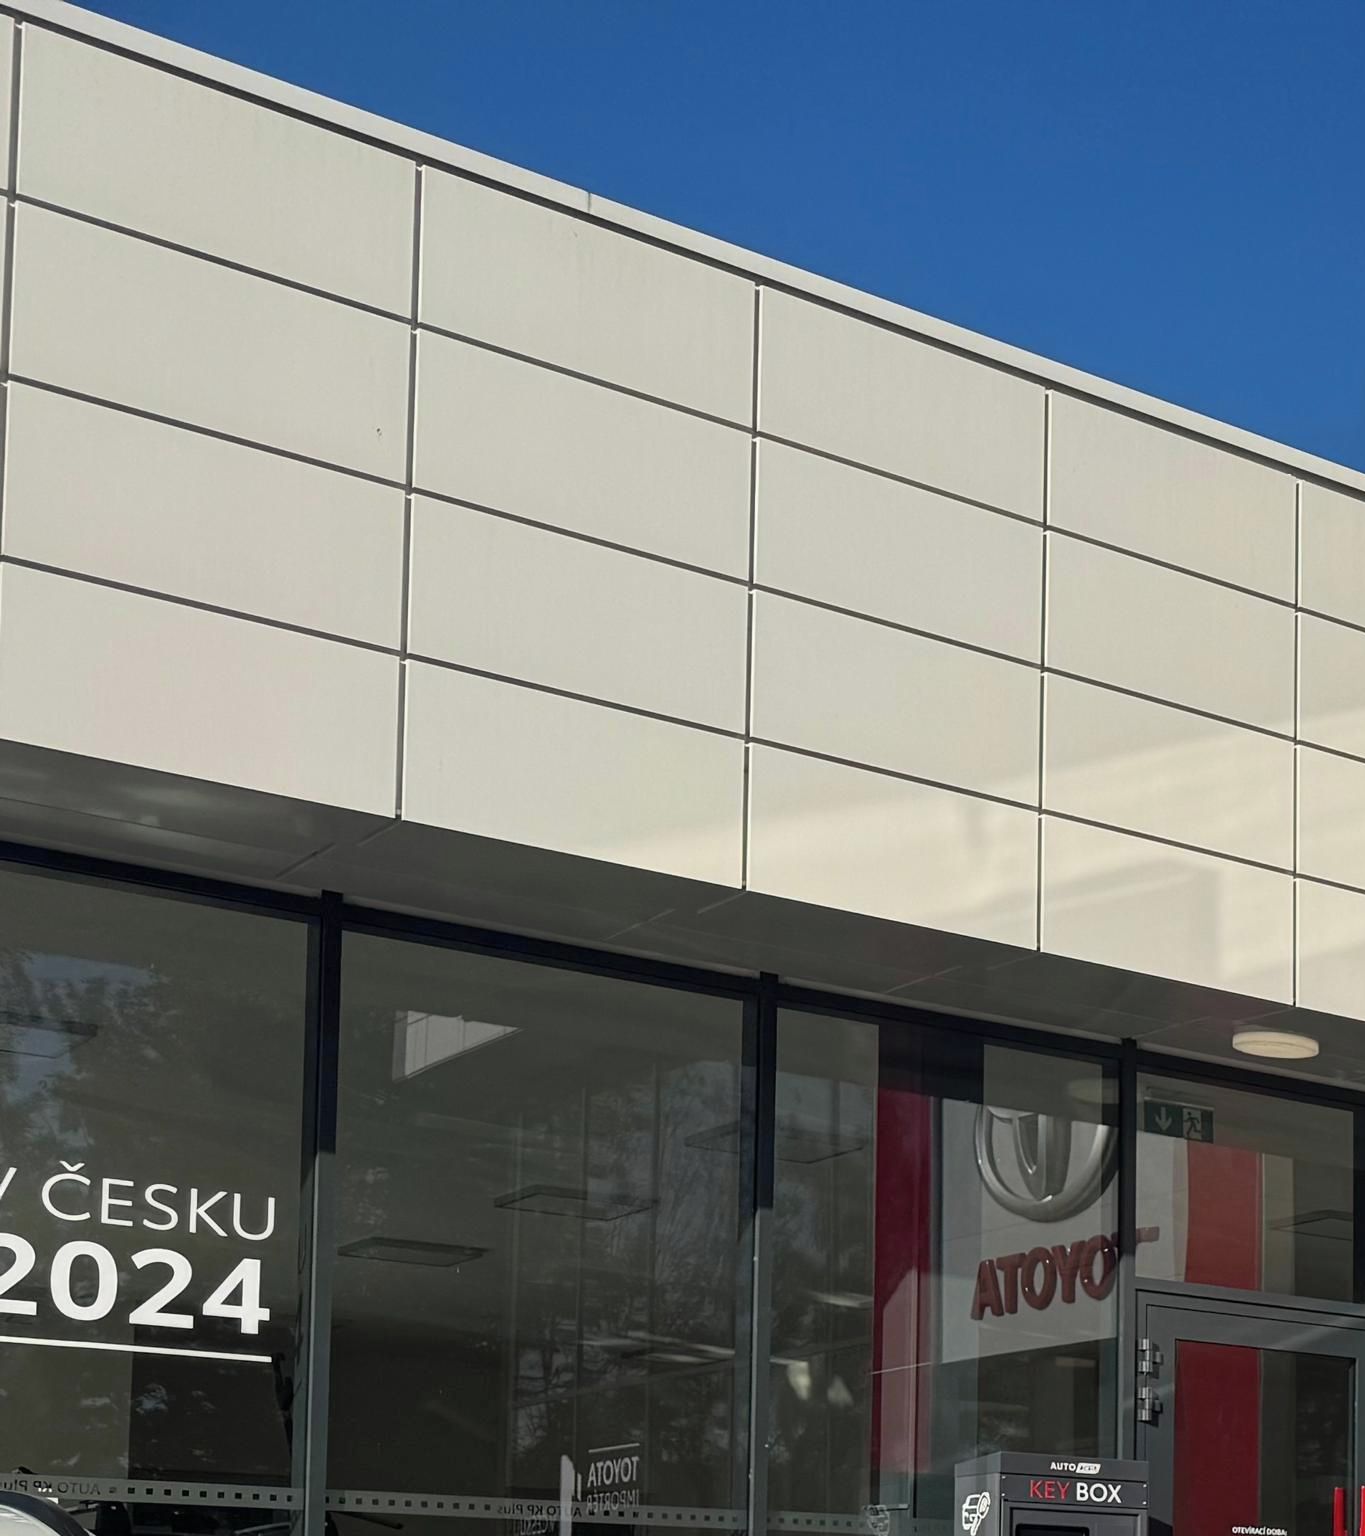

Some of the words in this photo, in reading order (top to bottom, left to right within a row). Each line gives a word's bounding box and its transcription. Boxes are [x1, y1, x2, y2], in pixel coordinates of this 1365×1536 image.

[41, 1160, 276, 1241] ČESKU
[1051, 1461, 1076, 1472] AUTO
[1030, 1479, 1071, 1499] KEY
[1076, 1482, 1122, 1503] BOX
